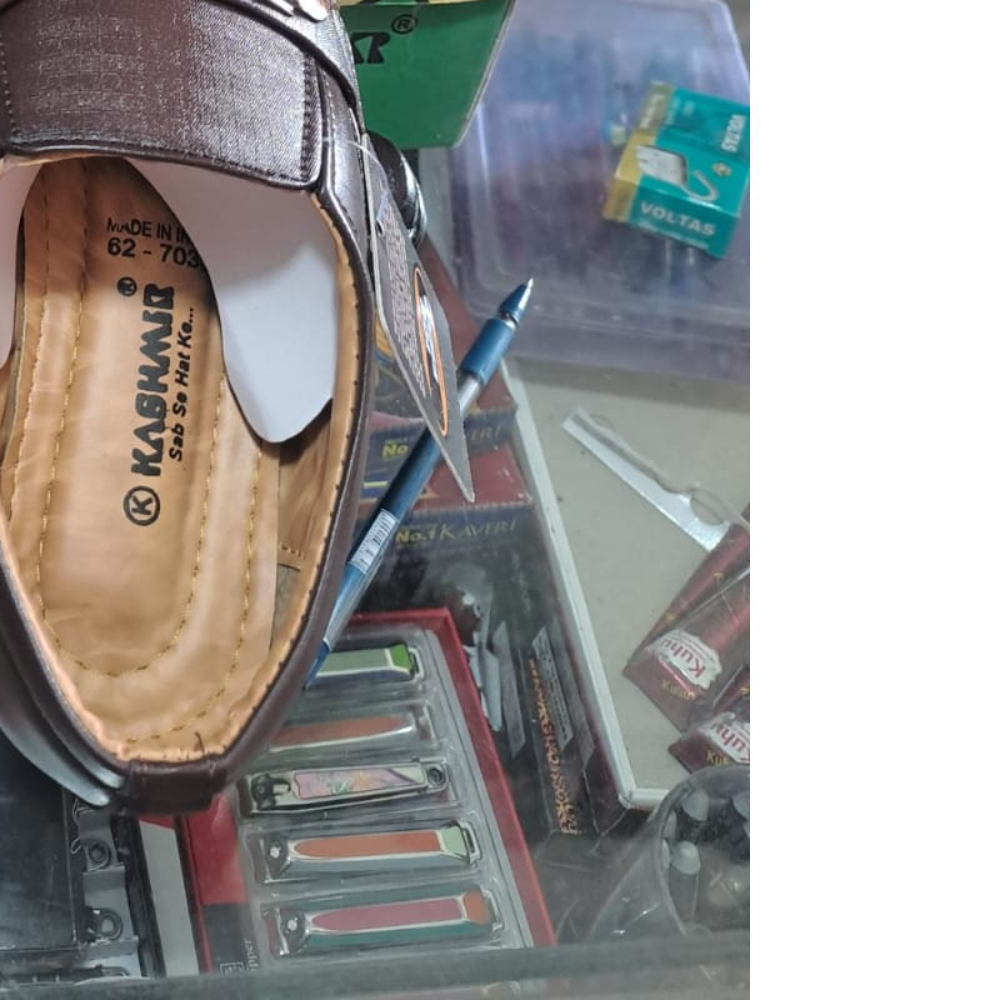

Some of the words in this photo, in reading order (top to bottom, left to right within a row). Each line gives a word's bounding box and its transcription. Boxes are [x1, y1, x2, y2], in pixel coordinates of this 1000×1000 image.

[106, 216, 152, 239] MADE
[156, 223, 172, 241] IN
[641, 201, 716, 237] VOLTAS
[107, 236, 136, 258] 62
[174, 351, 191, 387] Hat
[168, 422, 185, 462] Sab
[662, 638, 707, 679] Kuhu
